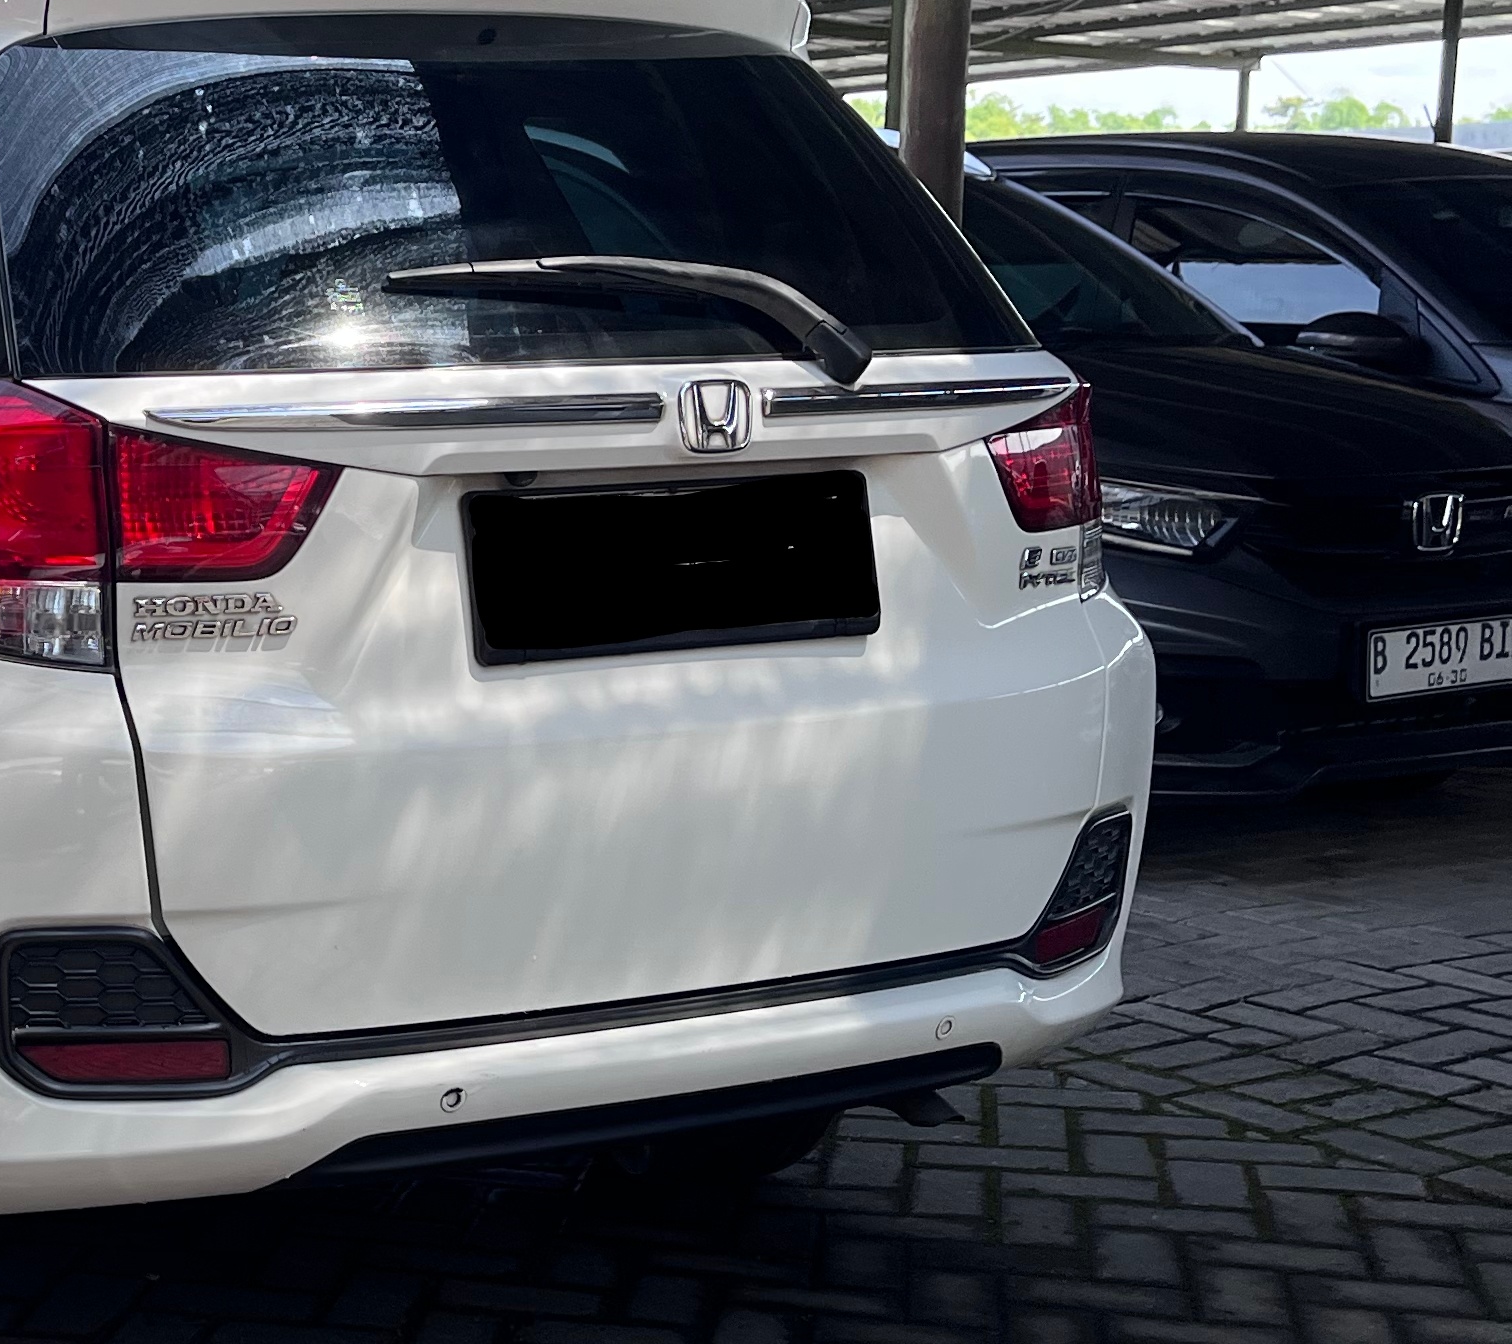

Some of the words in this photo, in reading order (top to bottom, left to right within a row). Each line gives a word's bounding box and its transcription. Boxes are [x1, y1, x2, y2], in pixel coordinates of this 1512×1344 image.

[134, 592, 283, 618] HONDA
[131, 615, 298, 642] MOBILIO
[1373, 635, 1387, 675] B
[1405, 625, 1469, 670] 2589
